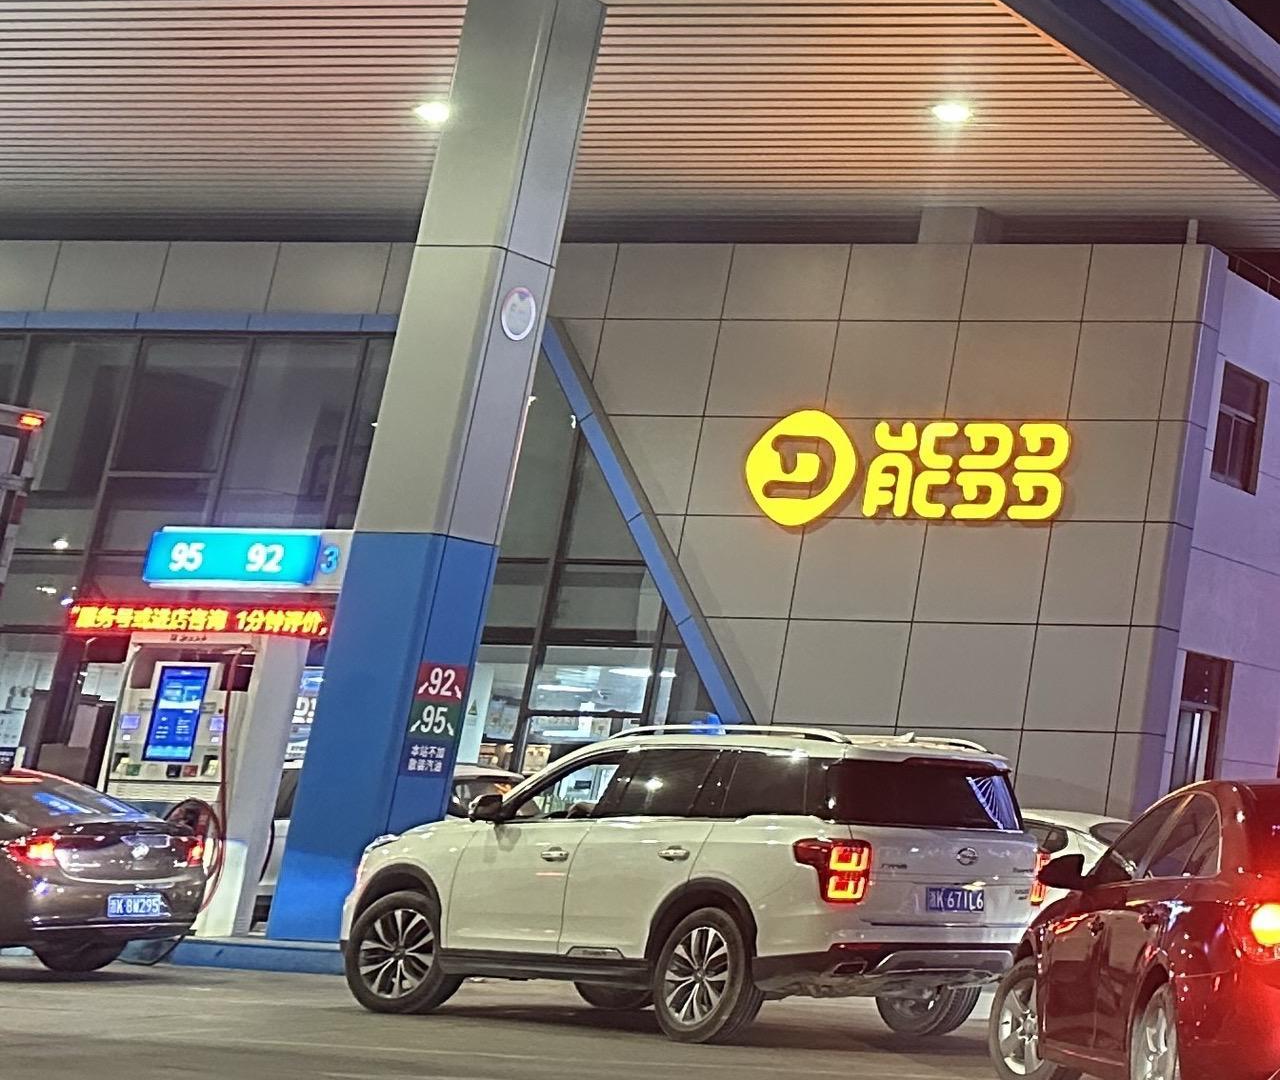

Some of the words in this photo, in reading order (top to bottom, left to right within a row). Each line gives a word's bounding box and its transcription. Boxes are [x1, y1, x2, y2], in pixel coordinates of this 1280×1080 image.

[168, 542, 206, 573] 95
[245, 543, 286, 573] 92
[320, 545, 341, 574] 3
[427, 667, 456, 697] 92
[420, 705, 448, 734] 95
[410, 744, 446, 759] 本站不加
